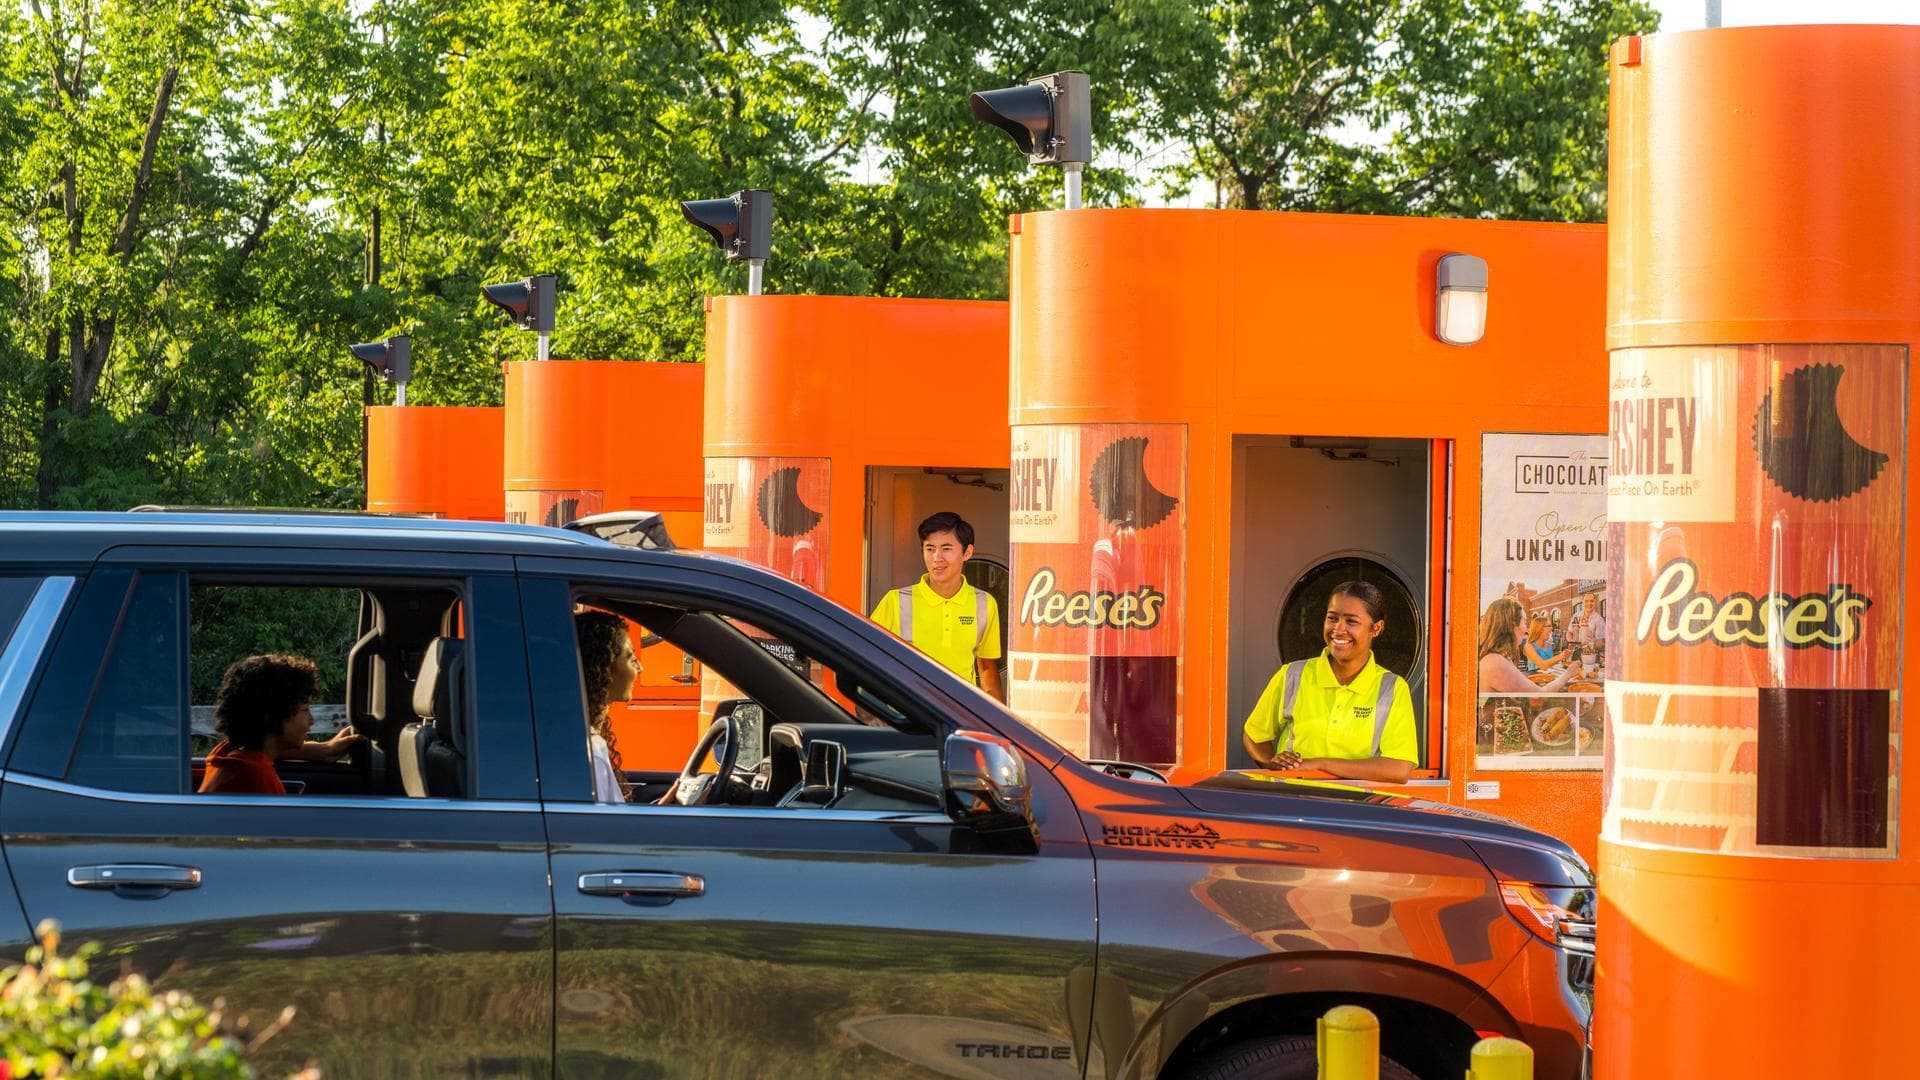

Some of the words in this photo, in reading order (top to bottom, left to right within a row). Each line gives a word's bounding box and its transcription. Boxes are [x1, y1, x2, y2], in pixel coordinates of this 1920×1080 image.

[1523, 464, 1607, 486] CHOCOLAT
[1644, 481, 1659, 495] On
[1506, 539, 1564, 561] LUNCH
[1570, 545, 1579, 556] &
[1019, 568, 1165, 629] Reese's
[1636, 560, 1869, 646] Reese's
[1102, 825, 1161, 837] HIGH
[1104, 836, 1216, 849] COUNTRY
[955, 1043, 1072, 1060] TAHOE
